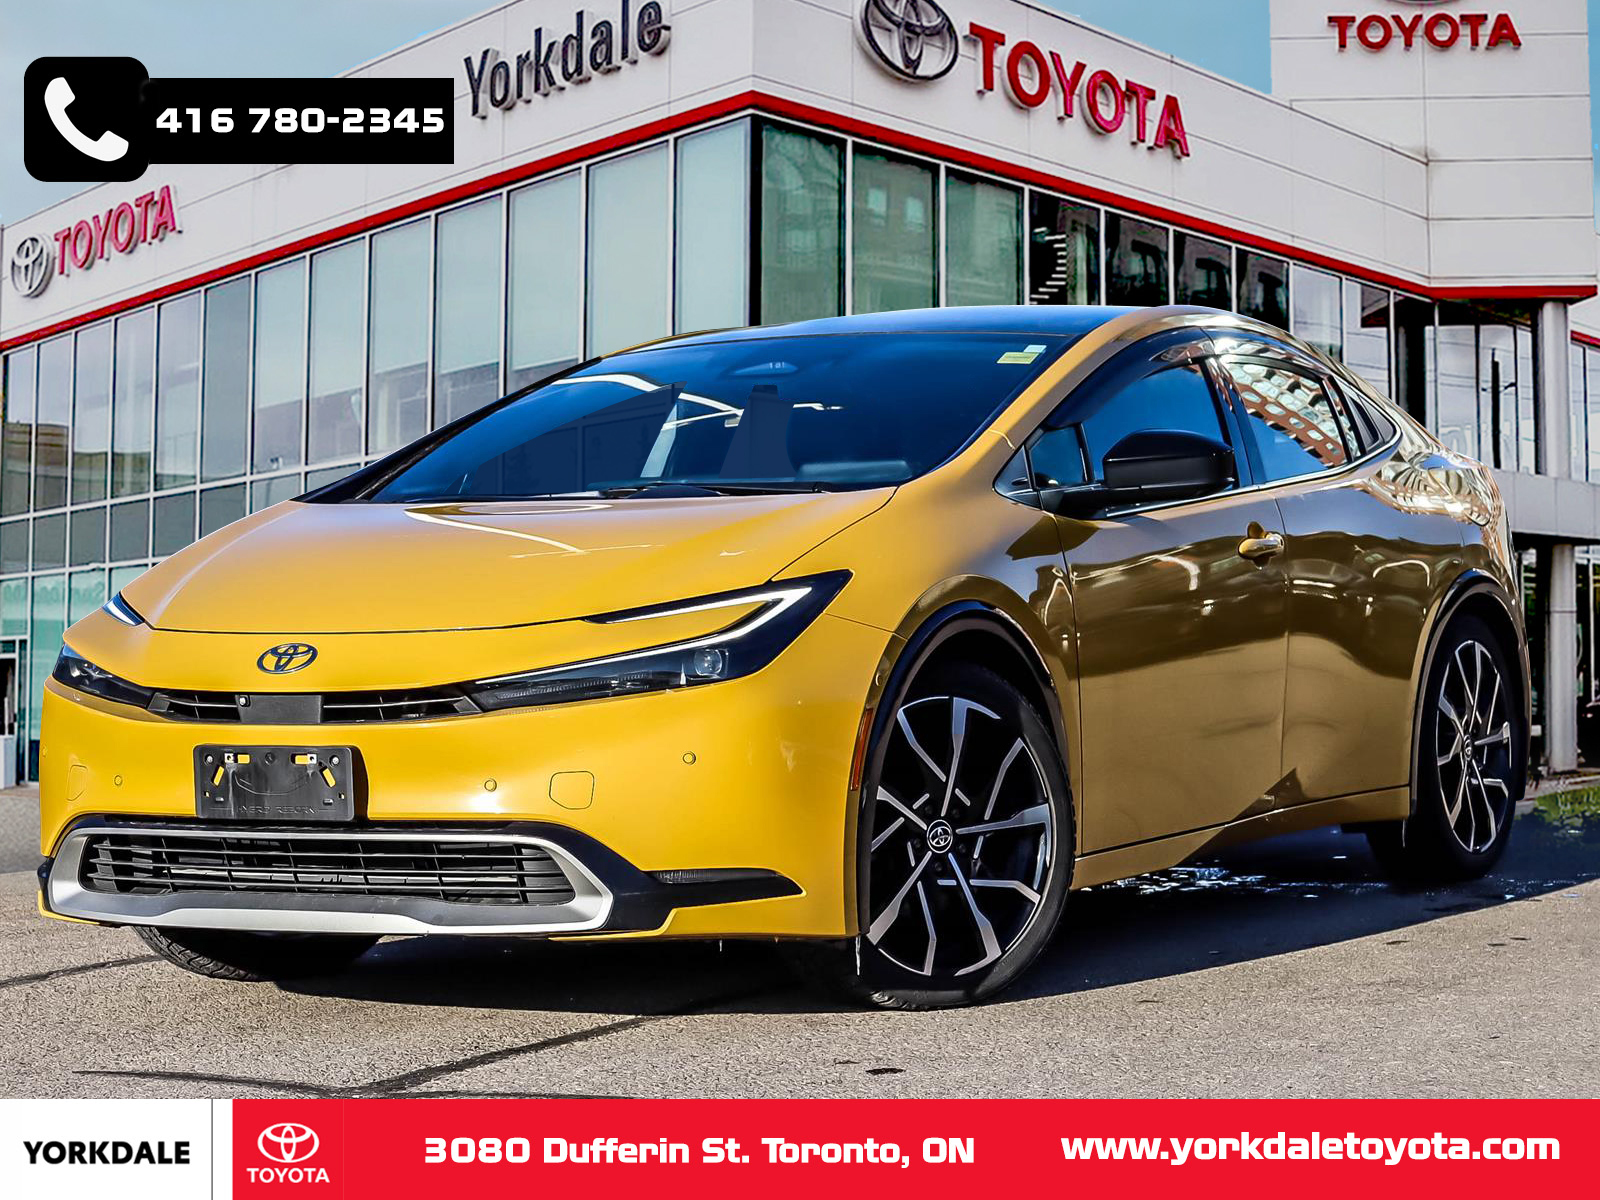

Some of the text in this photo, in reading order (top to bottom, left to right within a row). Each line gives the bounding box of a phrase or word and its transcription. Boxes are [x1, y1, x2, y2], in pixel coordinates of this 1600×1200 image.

[464, 0, 671, 120] Yorkdale
[1327, 12, 1522, 52] TOYOTA
[963, 21, 1191, 159] TOYOTA
[53, 184, 183, 278] TOYOTA
